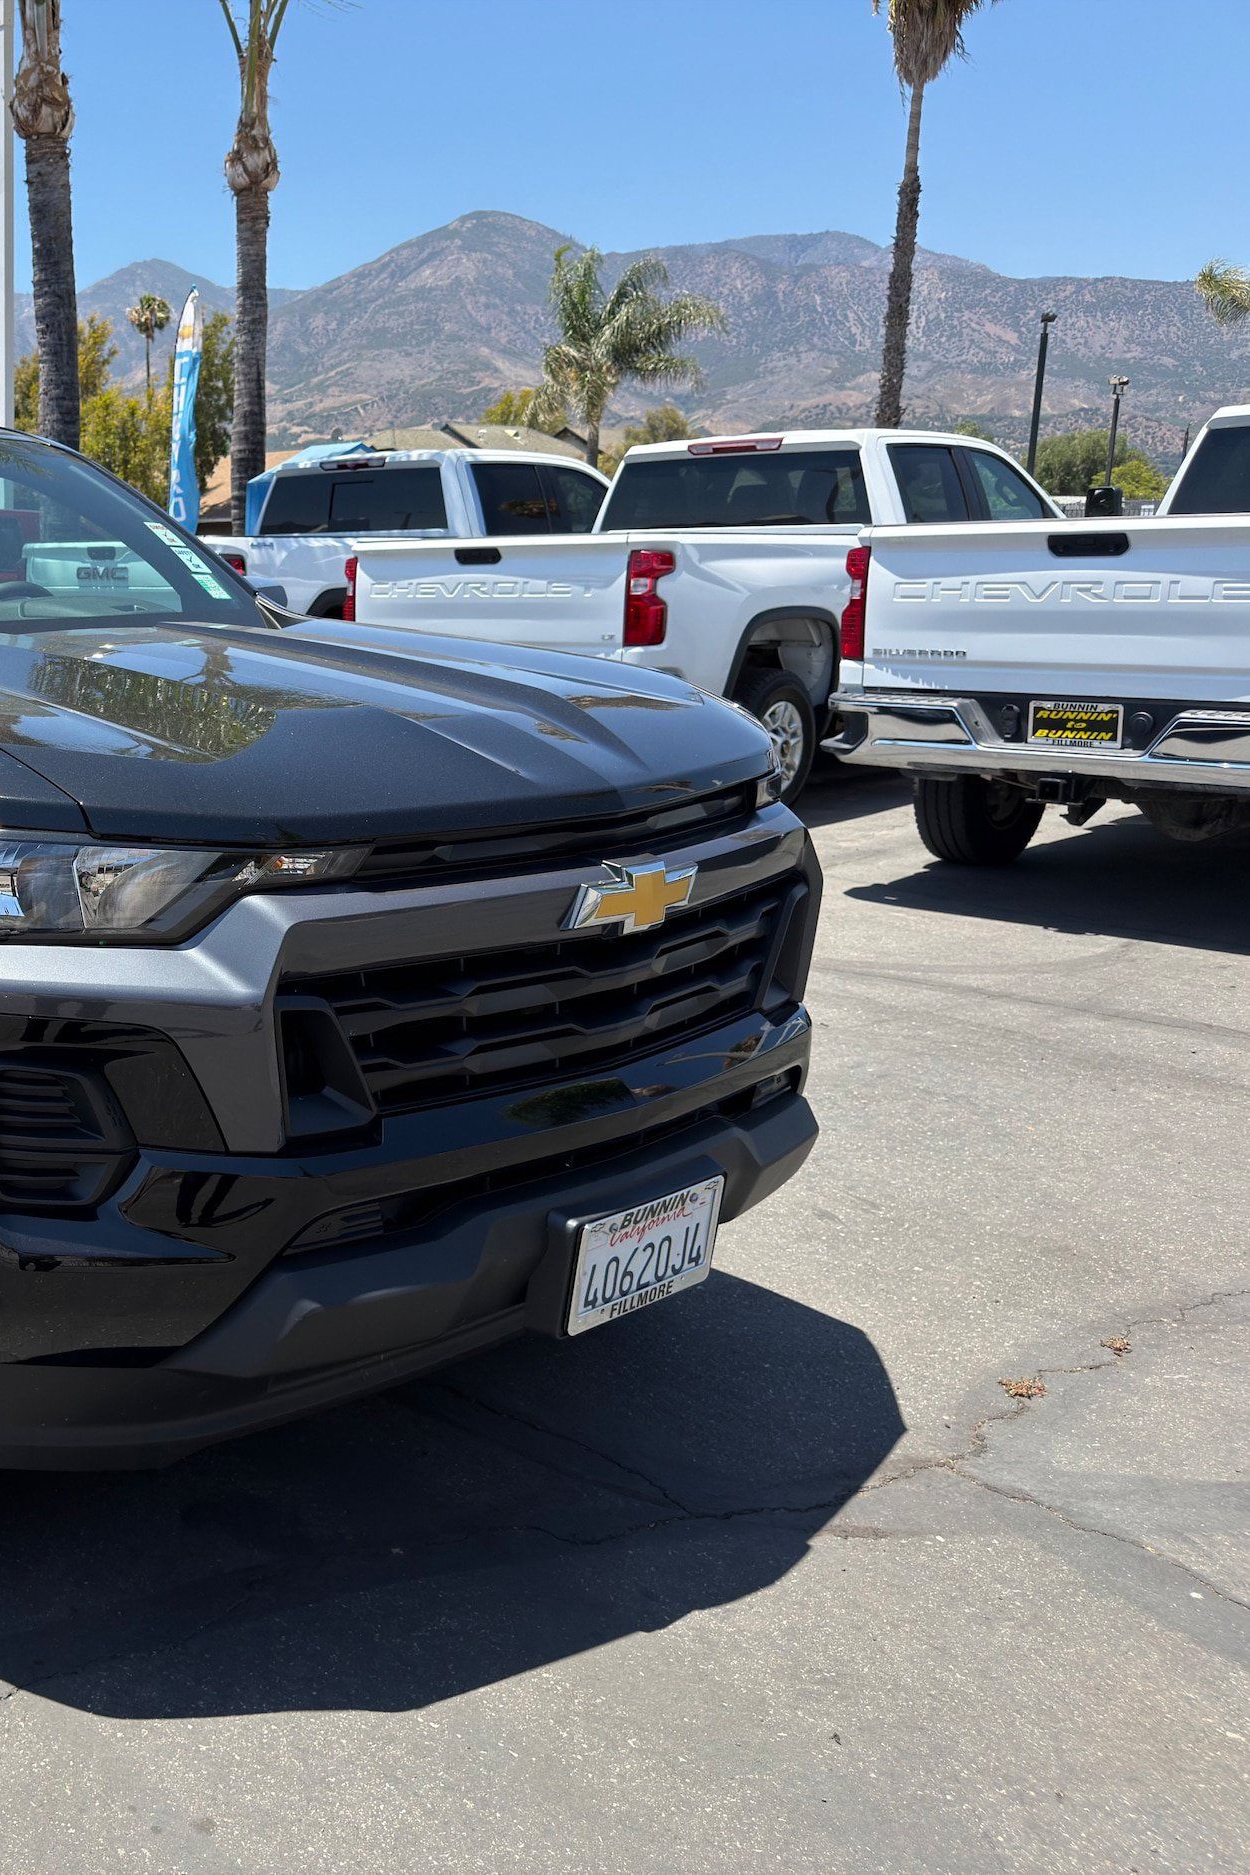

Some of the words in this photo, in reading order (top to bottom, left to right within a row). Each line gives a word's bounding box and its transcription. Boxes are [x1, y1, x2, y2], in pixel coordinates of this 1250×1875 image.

[77, 567, 128, 580] GMC
[369, 582, 597, 599] CHEVROLET
[893, 580, 1250, 603] CHEVROLE
[872, 648, 967, 657] SILVERADO
[1053, 703, 1098, 711] BUNNIN
[1036, 710, 1117, 720] RUNNIN'
[1066, 721, 1086, 729] to
[1034, 729, 1113, 740] BUNNIN
[1052, 739, 1093, 748] FILLMORE
[621, 1190, 690, 1230] BUNNIN
[610, 1205, 692, 1247] California
[584, 1223, 701, 1310] 40620J4
[609, 1279, 674, 1319] FILLMORE
